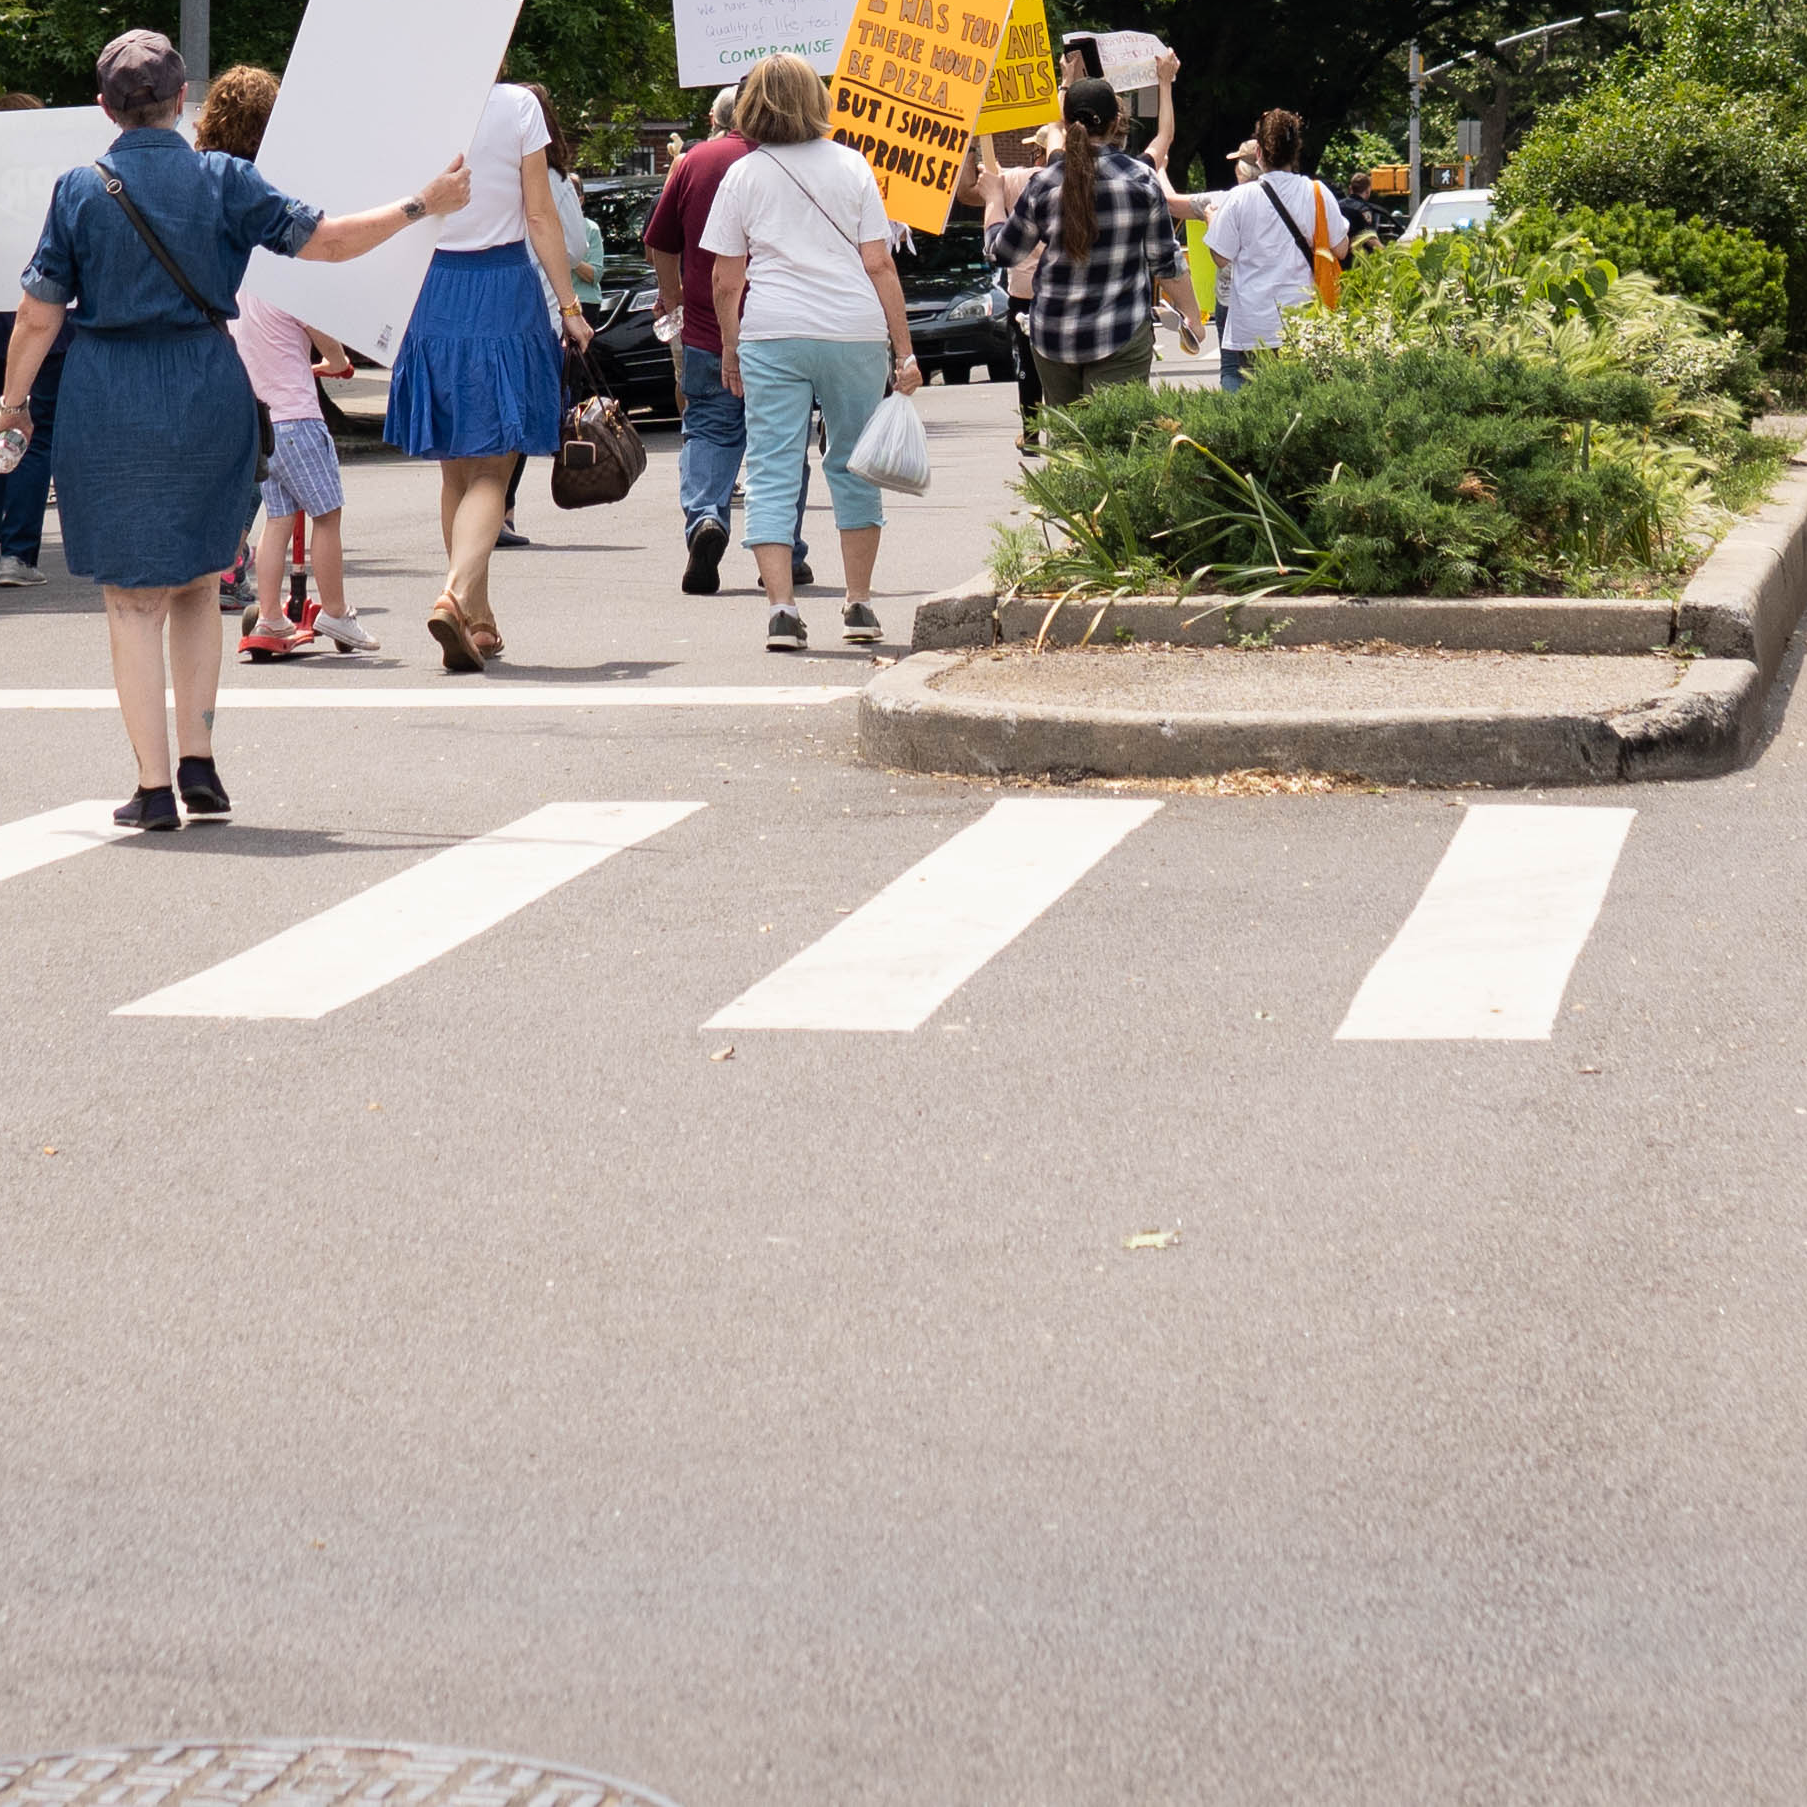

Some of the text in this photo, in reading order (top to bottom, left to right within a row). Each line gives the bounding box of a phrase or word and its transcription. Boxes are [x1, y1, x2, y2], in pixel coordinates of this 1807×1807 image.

[724, 1, 748, 11] have
[752, 18, 764, 34] of
[961, 13, 1000, 48] TOLD
[1006, 22, 1051, 60] AVE
[848, 50, 873, 80] BE
[858, 20, 987, 85] THERE WOULD
[837, 88, 969, 154] BUT I SUPPORT
[832, 128, 959, 195] OMPROMISE!
